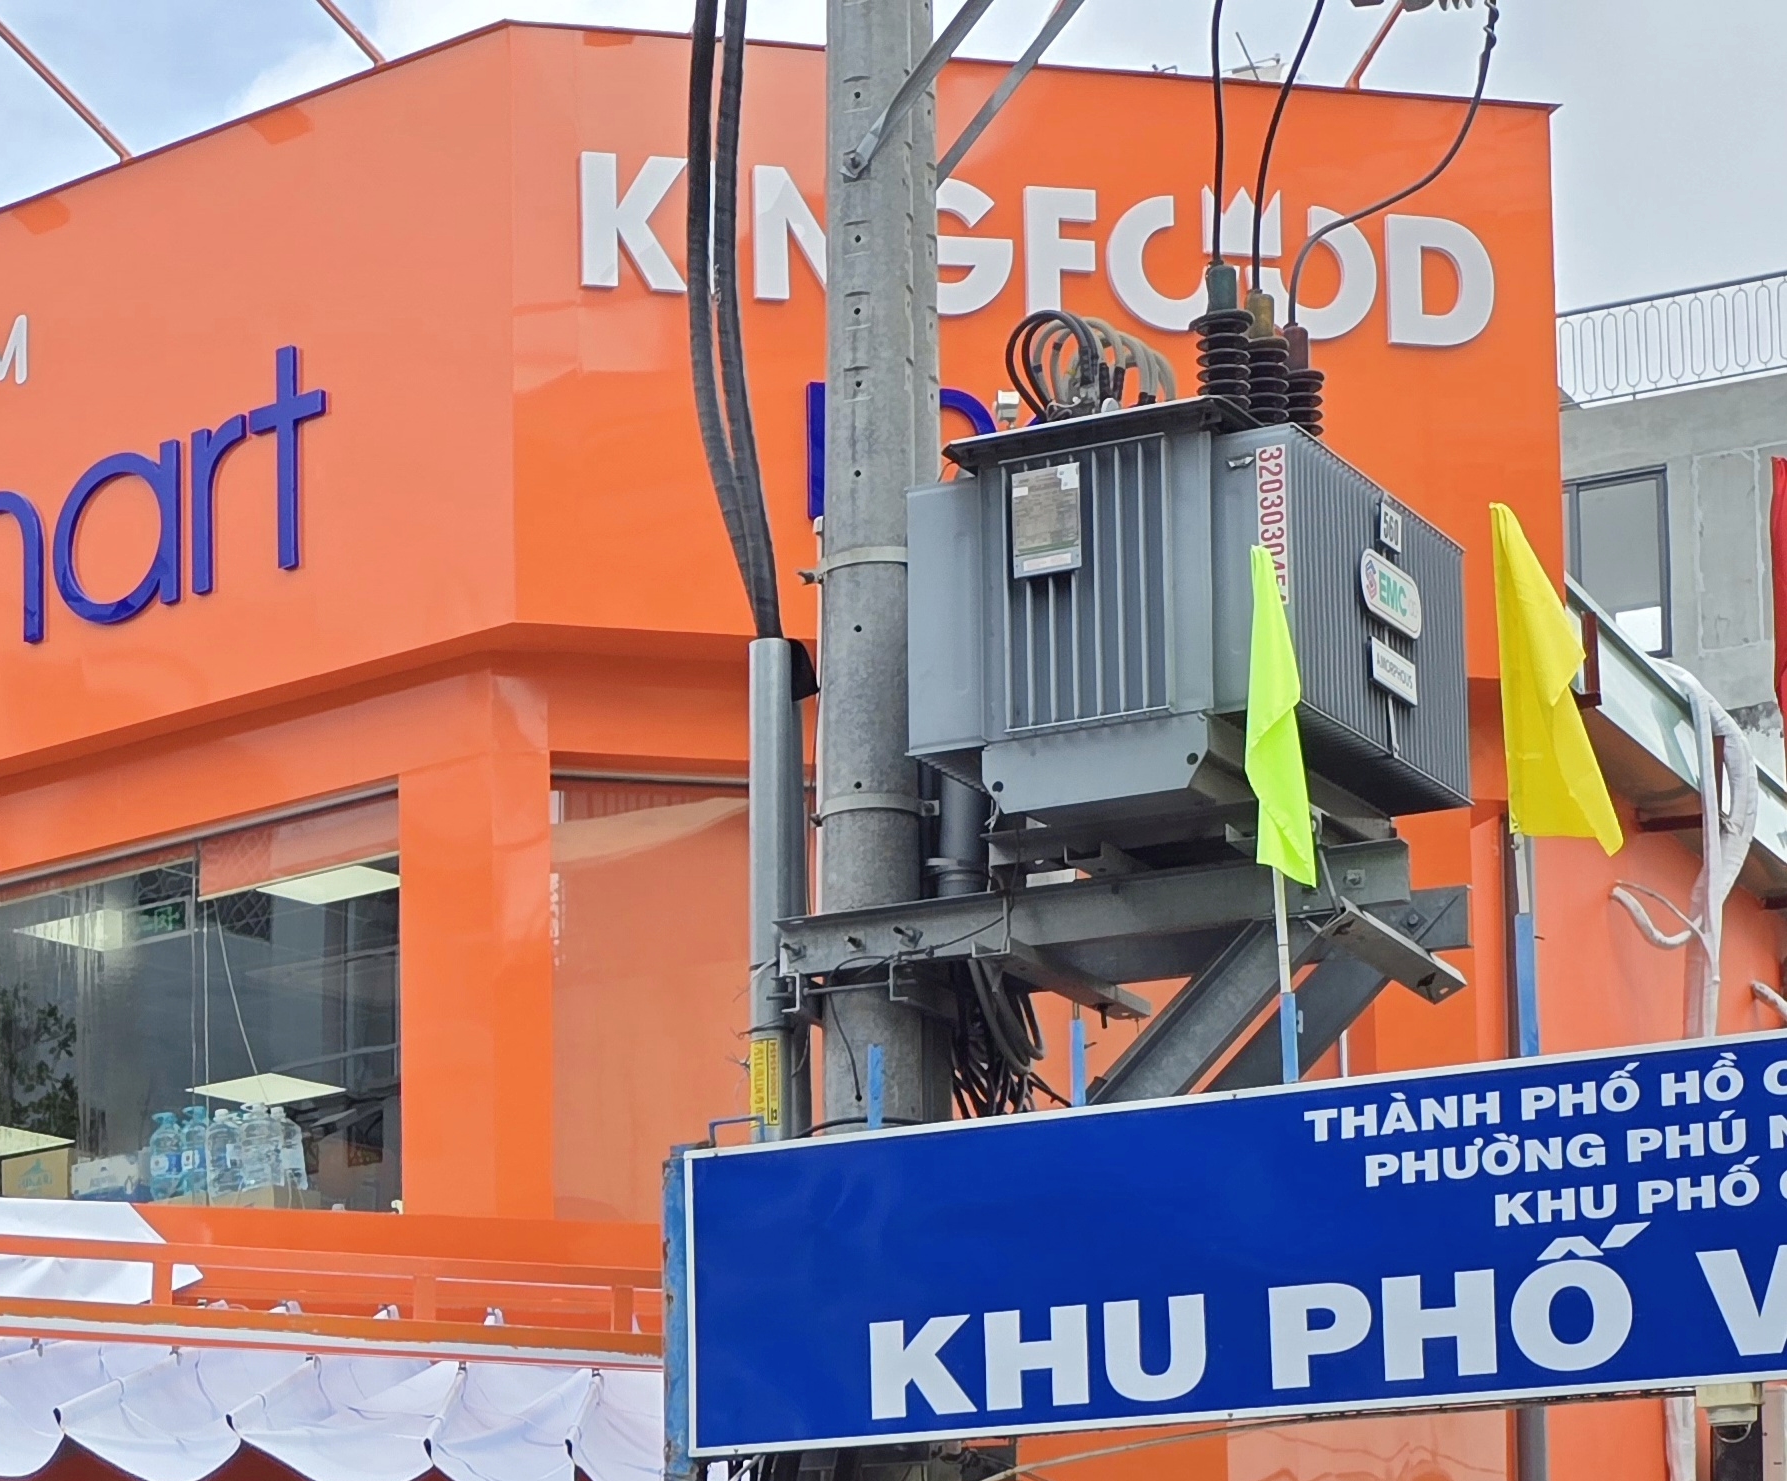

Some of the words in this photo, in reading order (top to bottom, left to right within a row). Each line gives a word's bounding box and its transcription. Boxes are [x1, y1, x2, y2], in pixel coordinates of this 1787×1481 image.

[580, 151, 1494, 347] KNGFOOD
[1384, 511, 1399, 546] 560
[1378, 569, 1407, 617] EMC
[1304, 1091, 1500, 1142] THÀNH
[1521, 1062, 1640, 1120] PHỐ
[1660, 1052, 1744, 1106] HỒ
[1365, 1133, 1606, 1188] PHƯỜNG
[1626, 1109, 1747, 1163] PHÚ
[1494, 1183, 1617, 1227] KHU
[1637, 1155, 1760, 1214] PHỐ
[869, 1293, 1208, 1420] KHU
[1267, 1221, 1651, 1391] PHỐ
